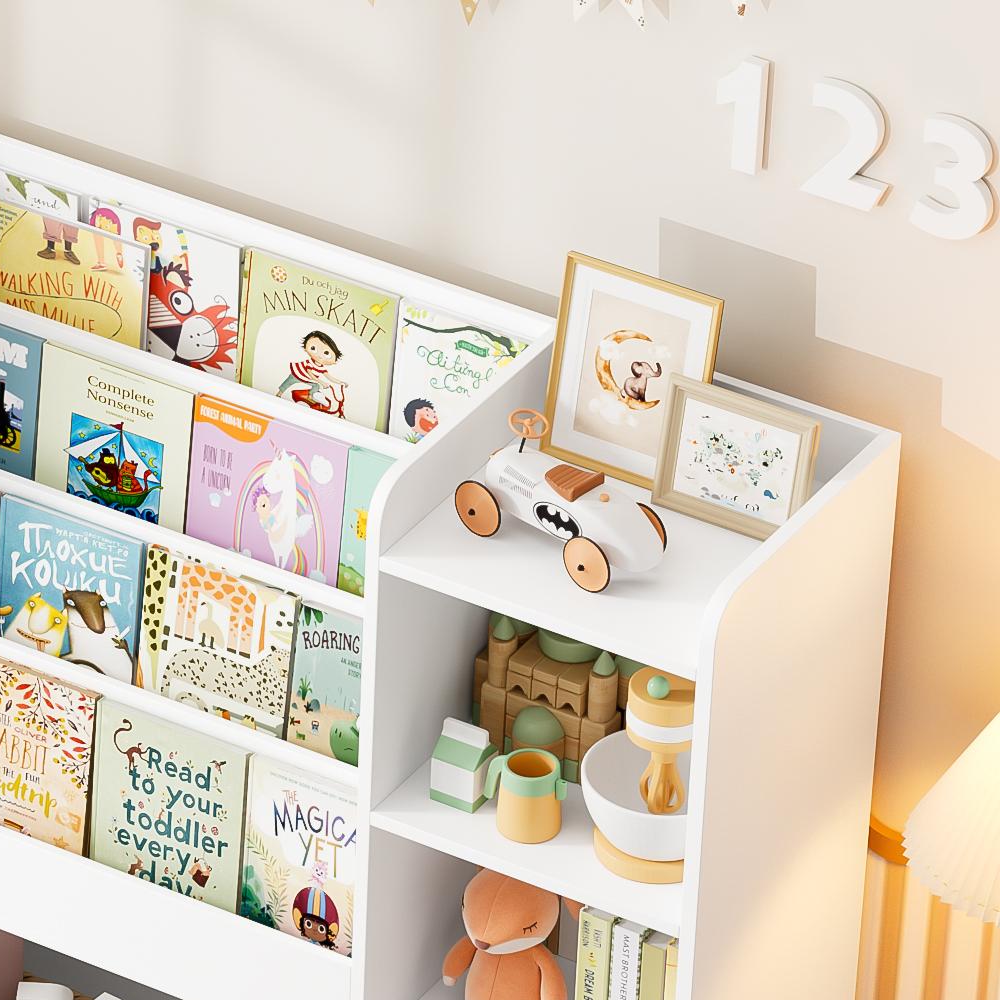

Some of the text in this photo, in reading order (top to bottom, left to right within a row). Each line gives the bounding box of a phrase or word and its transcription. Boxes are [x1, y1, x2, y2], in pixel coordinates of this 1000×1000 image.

[716, 56, 998, 241] 1 2 3
[83, 273, 124, 311] WITH
[302, 275, 315, 286] Du
[263, 289, 386, 344] MIN SKATT
[86, 388, 154, 421] Nonsense
[87, 375, 155, 407] Complete
[302, 629, 361, 654] ROARING
[147, 746, 212, 792] Read
[129, 767, 223, 819] to your
[281, 788, 299, 806] THE
[123, 798, 229, 858] toddler
[117, 828, 191, 876] every
[298, 832, 343, 878] YET
[622, 934, 630, 959] MAST
[584, 968, 595, 995] DREAM
